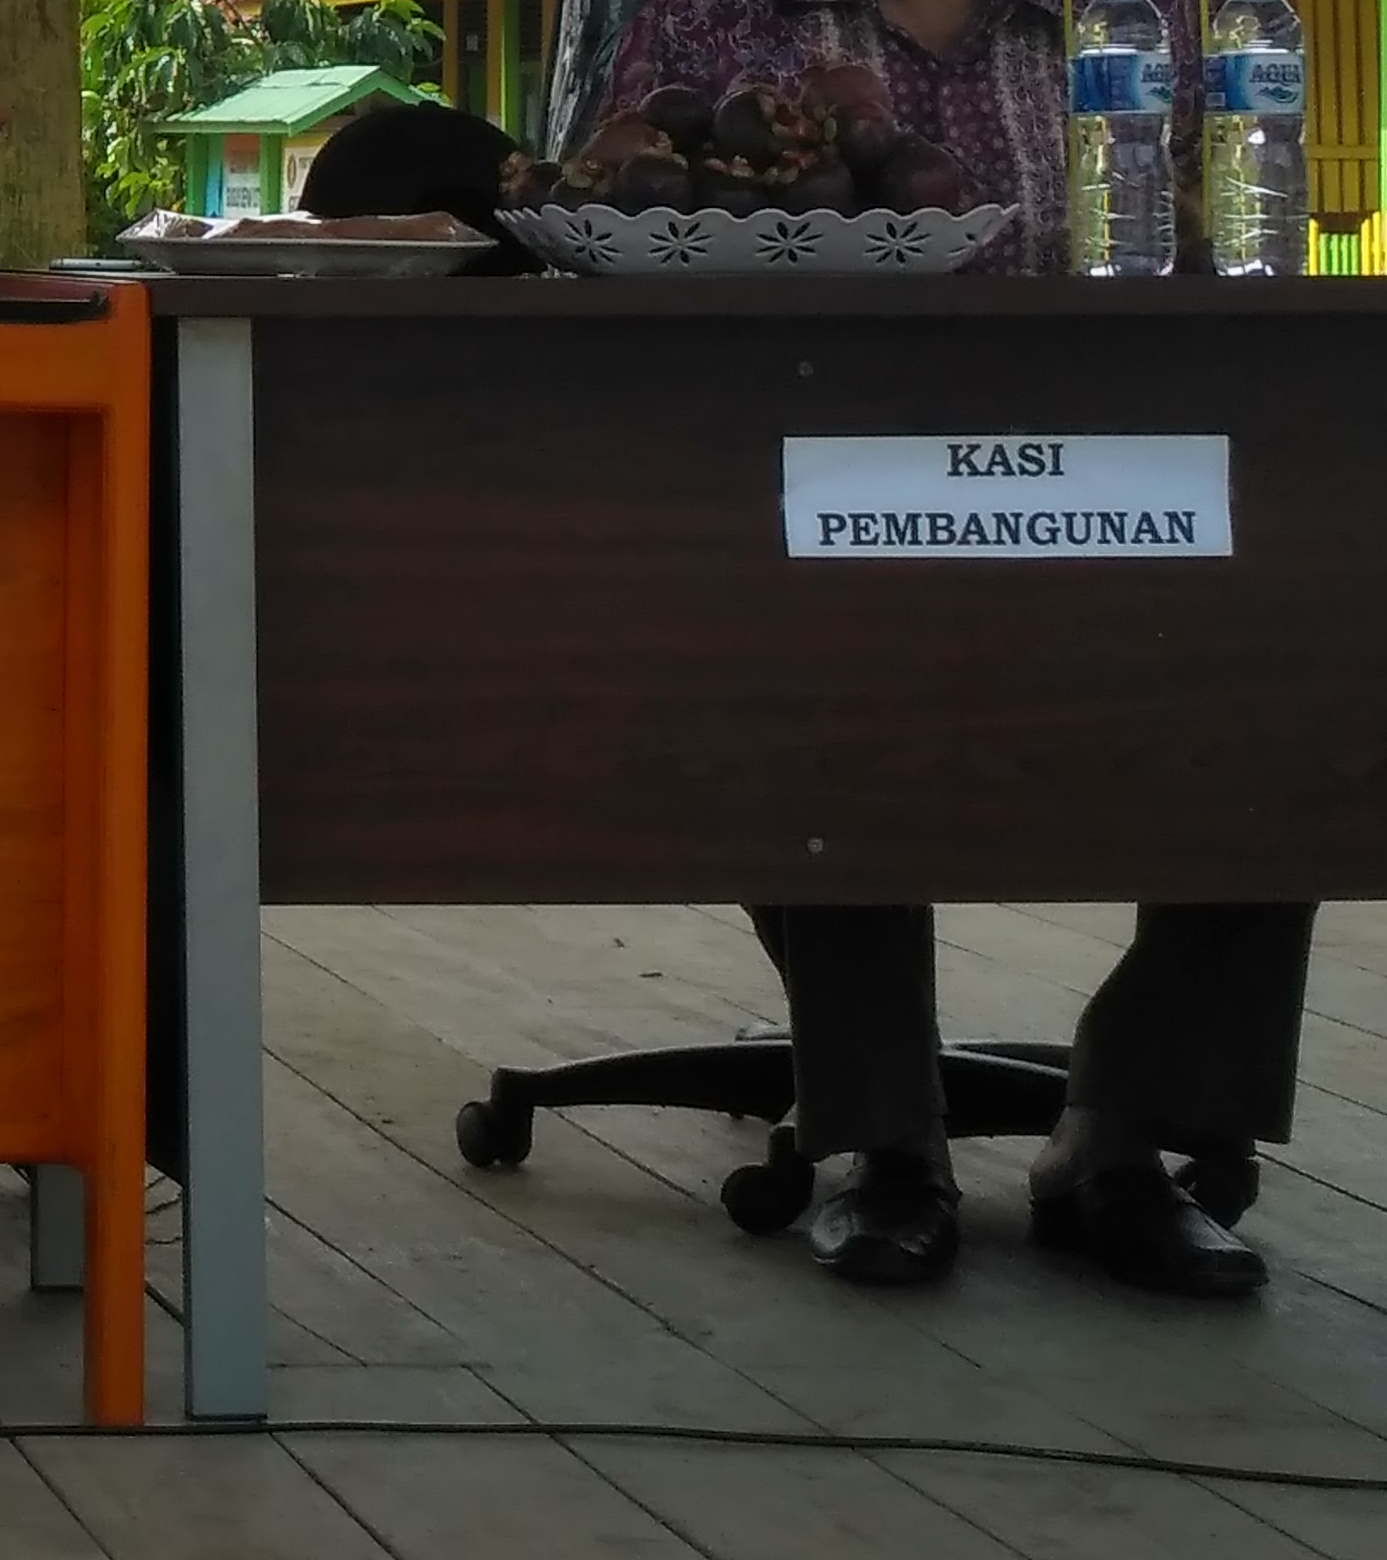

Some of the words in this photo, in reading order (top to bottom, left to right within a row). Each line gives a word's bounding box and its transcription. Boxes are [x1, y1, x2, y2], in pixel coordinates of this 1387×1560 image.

[1249, 62, 1302, 86] AQUA
[946, 443, 1066, 478] KASI
[815, 509, 1198, 548] PEMBANGUNAN
